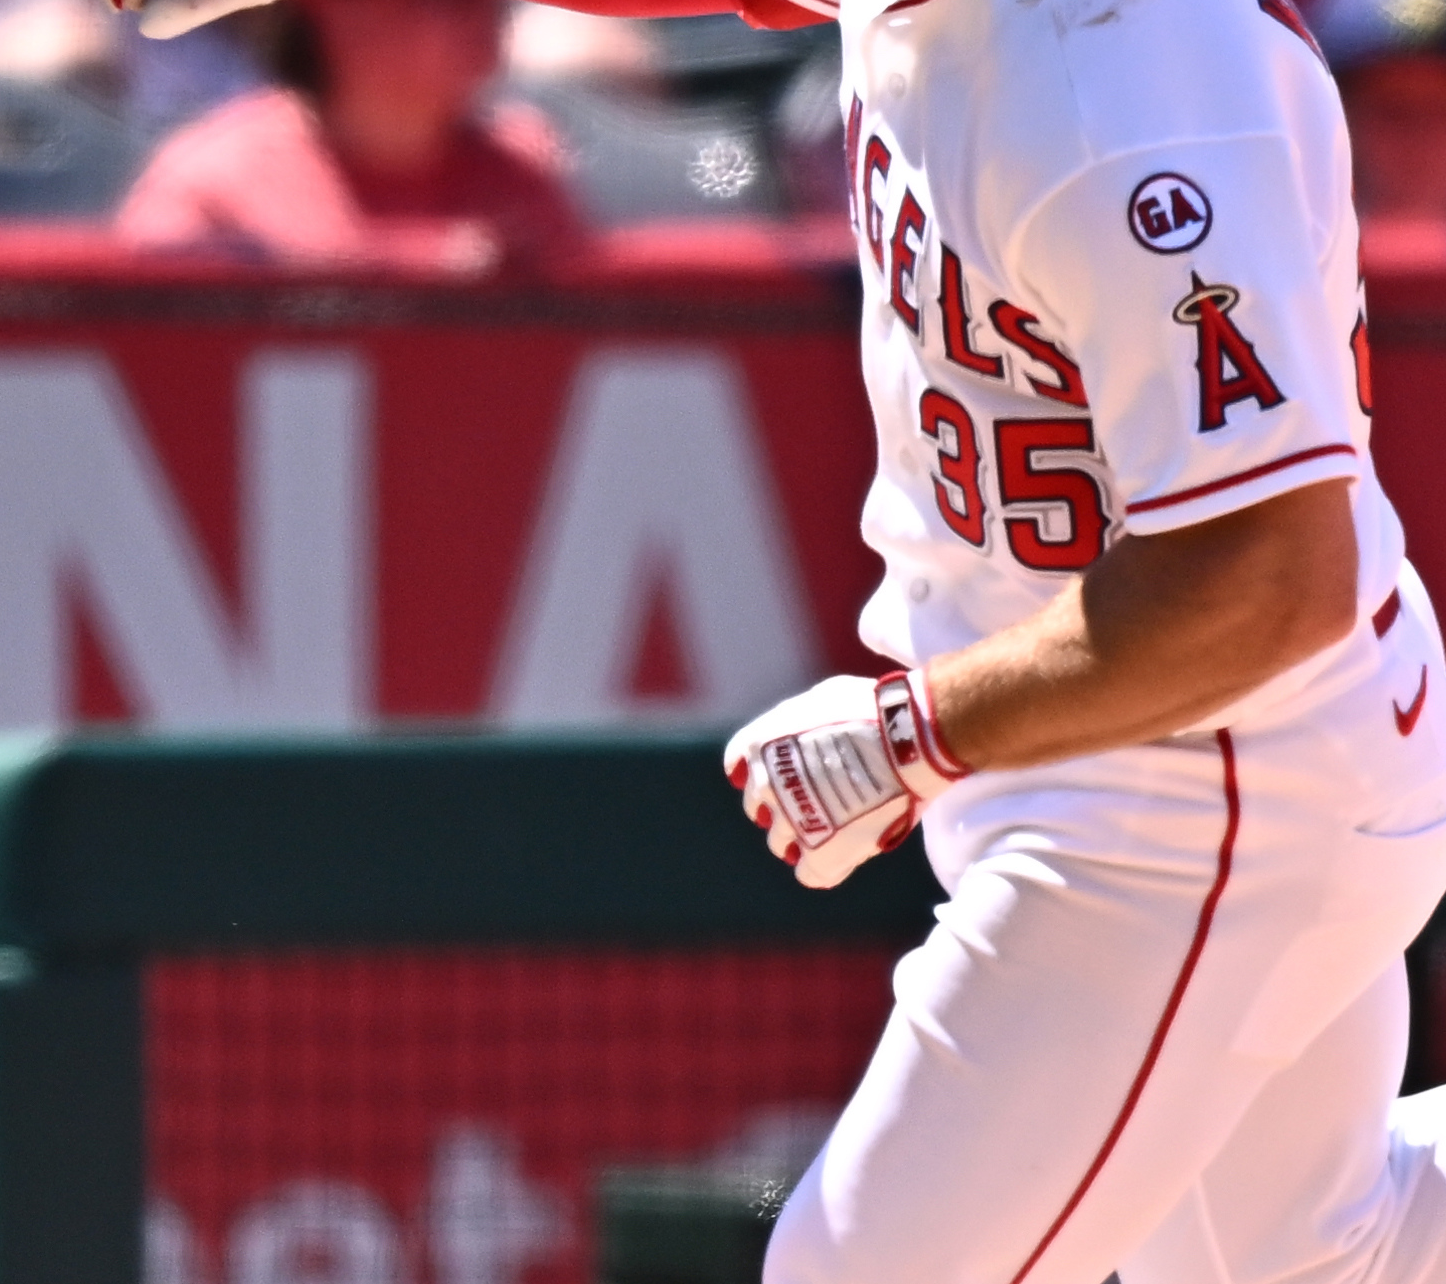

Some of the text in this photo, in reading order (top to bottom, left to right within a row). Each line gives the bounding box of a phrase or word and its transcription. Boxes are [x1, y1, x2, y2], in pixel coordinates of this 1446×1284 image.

[1136, 187, 1204, 239] GA
[1172, 269, 1287, 433] A
[919, 386, 1111, 573] 35
